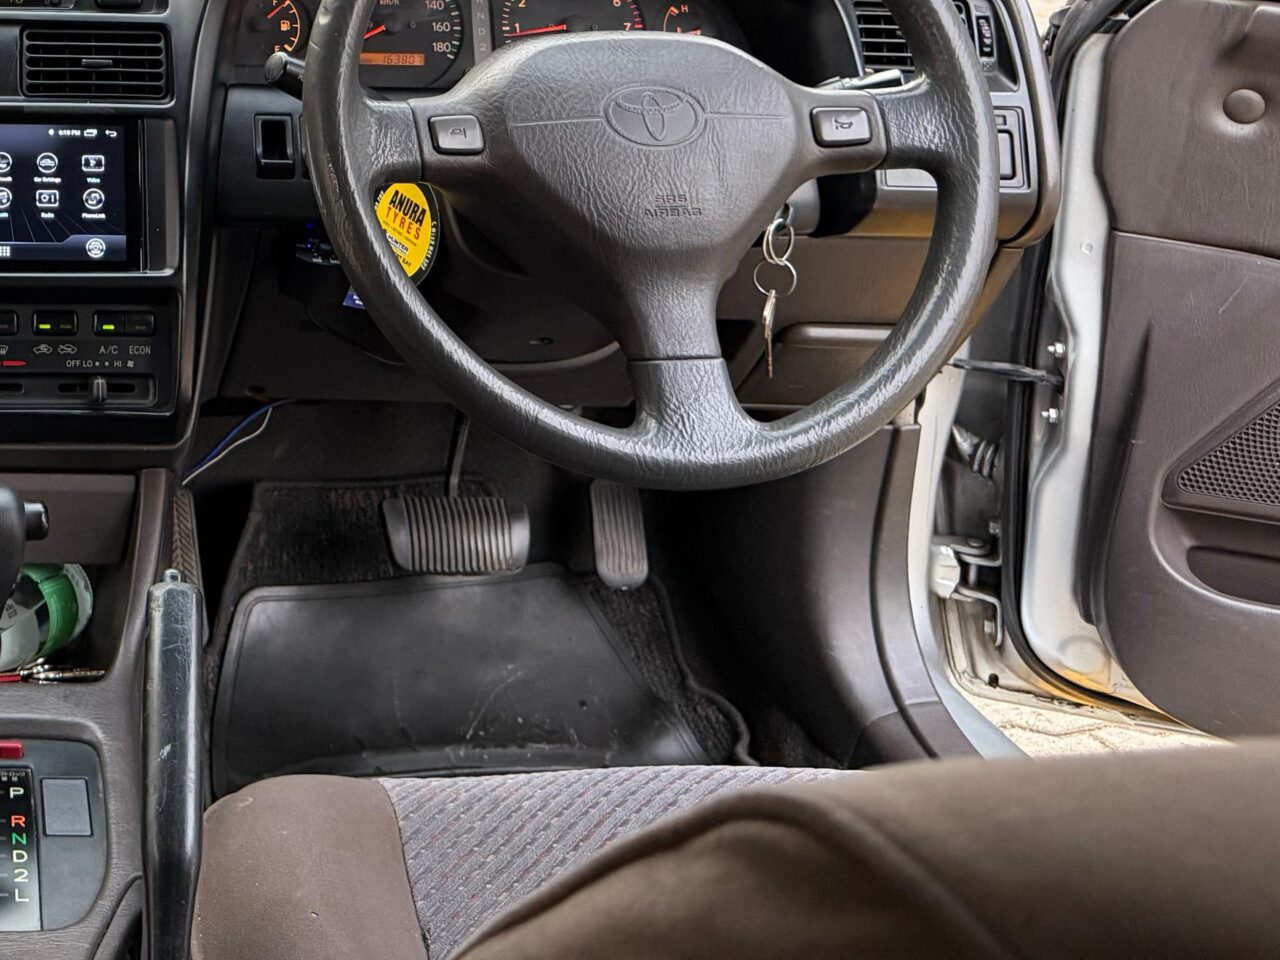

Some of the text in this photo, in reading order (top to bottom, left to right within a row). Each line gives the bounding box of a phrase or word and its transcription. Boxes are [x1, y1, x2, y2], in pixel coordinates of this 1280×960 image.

[425, 0, 444, 10] 140
[681, 5, 689, 13] H
[477, 12, 485, 20] N
[432, 22, 451, 32] 160
[478, 27, 486, 35] D
[624, 23, 631, 31] 7
[432, 42, 451, 52] 180
[479, 42, 487, 51] 2
[389, 189, 427, 228] ANURA
[385, 207, 421, 240] TYRES
[99, 345, 151, 355] A/C ECON
[9, 787, 24, 799] P
[10, 815, 26, 828] R
[11, 833, 27, 845] N
[12, 850, 28, 863] D
[14, 868, 29, 882] 2
[15, 888, 29, 902] L
